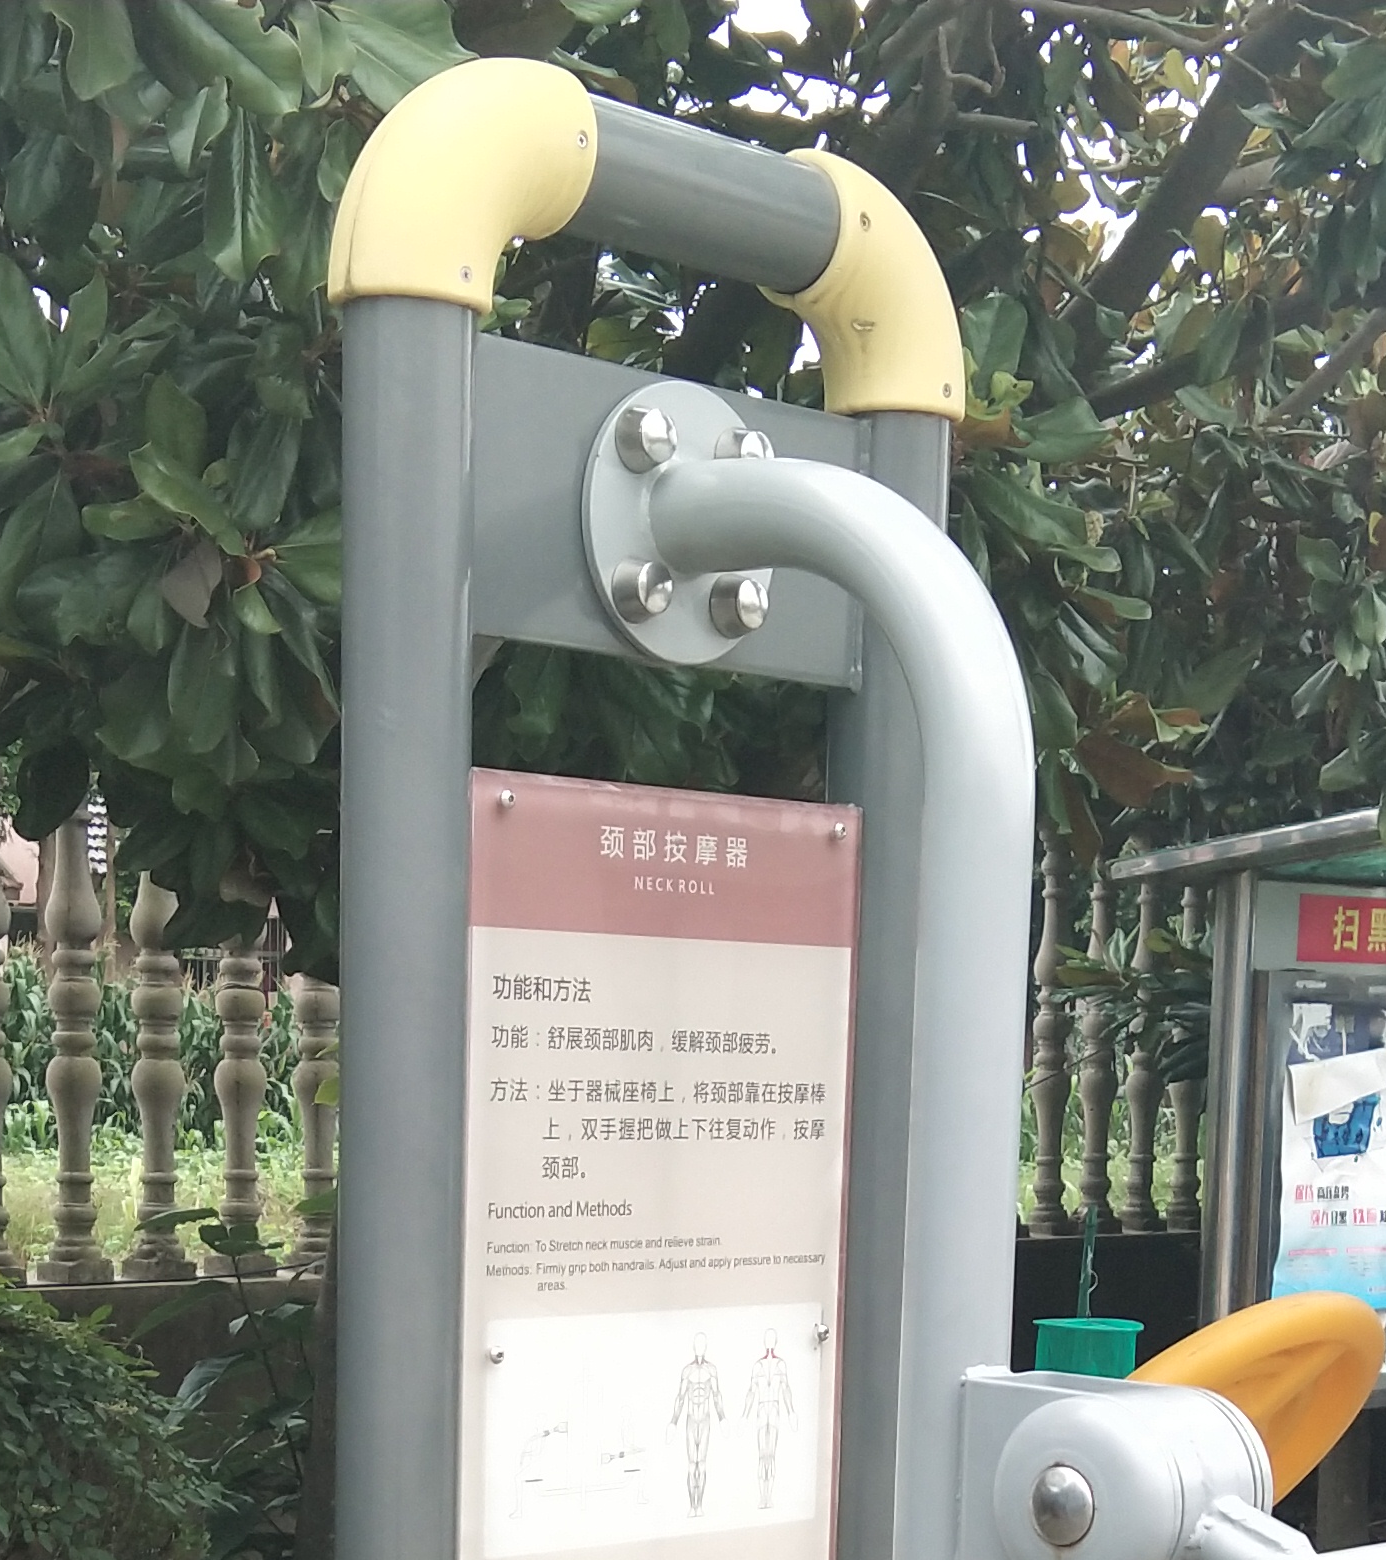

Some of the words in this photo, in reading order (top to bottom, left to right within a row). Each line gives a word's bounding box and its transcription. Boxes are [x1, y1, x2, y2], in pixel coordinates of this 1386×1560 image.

[600, 825, 749, 868] 颈部按摩器
[492, 974, 591, 1003] 功能和方法
[542, 1156, 587, 1179] 颈部。
[488, 1202, 545, 1219] Function
[548, 1200, 572, 1218] and
[576, 1199, 633, 1217] Methods
[585, 1240, 607, 1250] neck
[610, 1238, 642, 1250] muscle
[645, 1236, 662, 1248] and
[589, 1261, 609, 1272] both
[690, 1257, 706, 1268] and
[708, 1256, 732, 1269] apply
[734, 1255, 771, 1268] pressure
[773, 1254, 781, 1265] to
[783, 1253, 825, 1266] necessary
